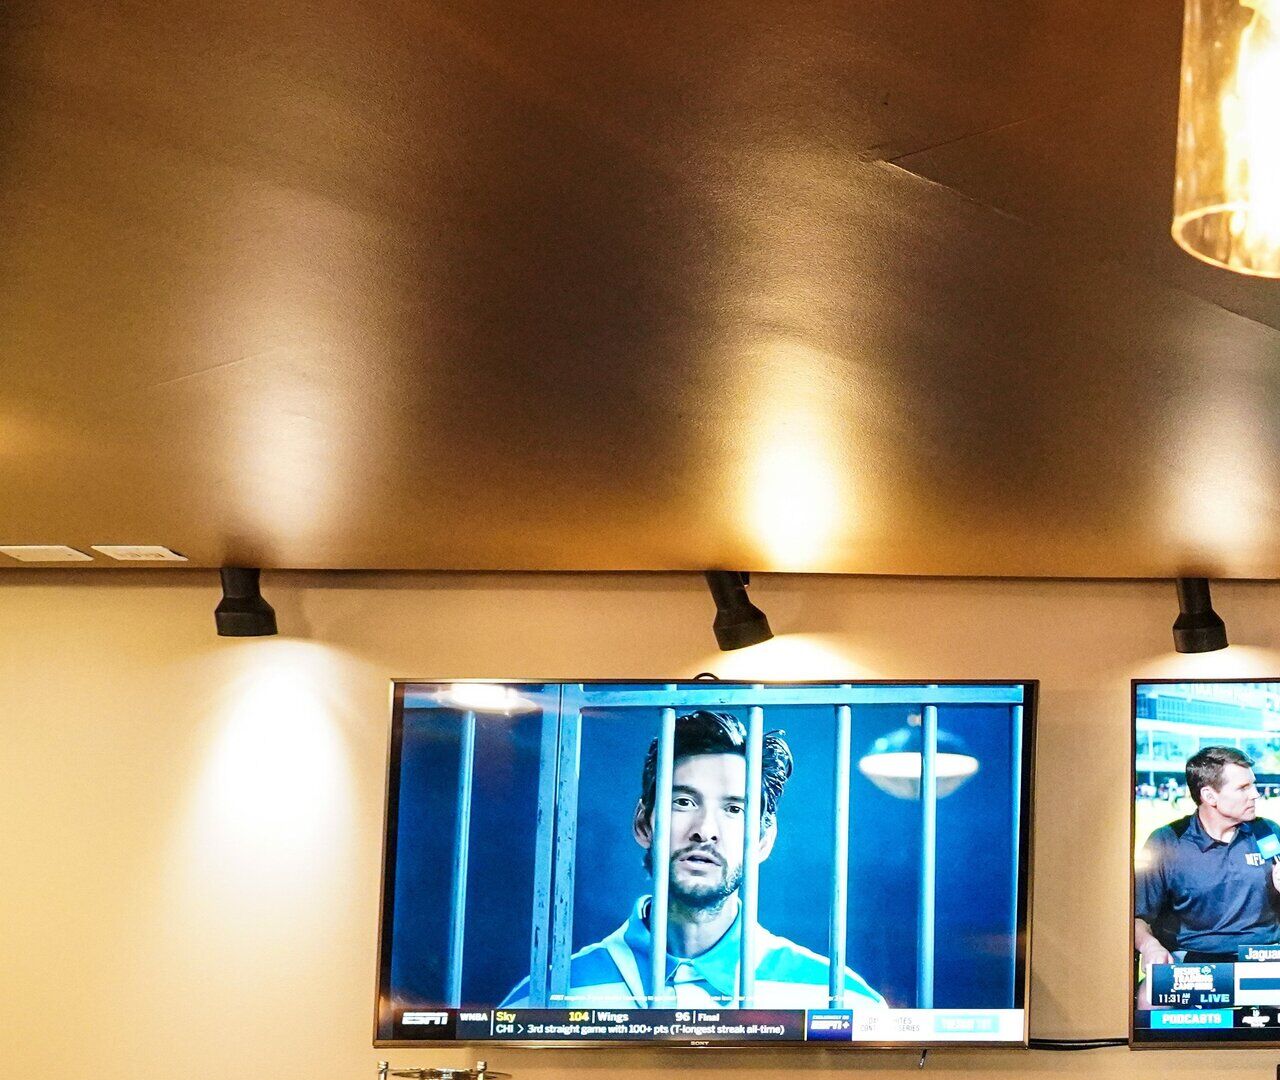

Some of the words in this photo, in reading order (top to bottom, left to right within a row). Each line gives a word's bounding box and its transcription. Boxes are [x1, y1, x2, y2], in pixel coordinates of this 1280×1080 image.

[1159, 994, 1181, 1003] 11:31
[1200, 994, 1230, 1003] LIVE
[460, 1013, 488, 1022] WNBA
[496, 1011, 517, 1024] Sky
[568, 1011, 590, 1022] 104
[597, 1012, 630, 1024] Wings
[675, 1012, 691, 1022] 96
[698, 1013, 720, 1022] Final
[496, 1024, 514, 1034] CHI
[527, 1024, 543, 1034] 3rd
[544, 1024, 580, 1036] straight
[581, 1026, 607, 1036] game
[608, 1024, 627, 1034] with
[629, 1024, 653, 1034] 100+
[654, 1025, 669, 1036] pts
[670, 1024, 715, 1037] (T-longest
[717, 1024, 747, 1035] streak
[747, 1024, 785, 1036] all-time)
